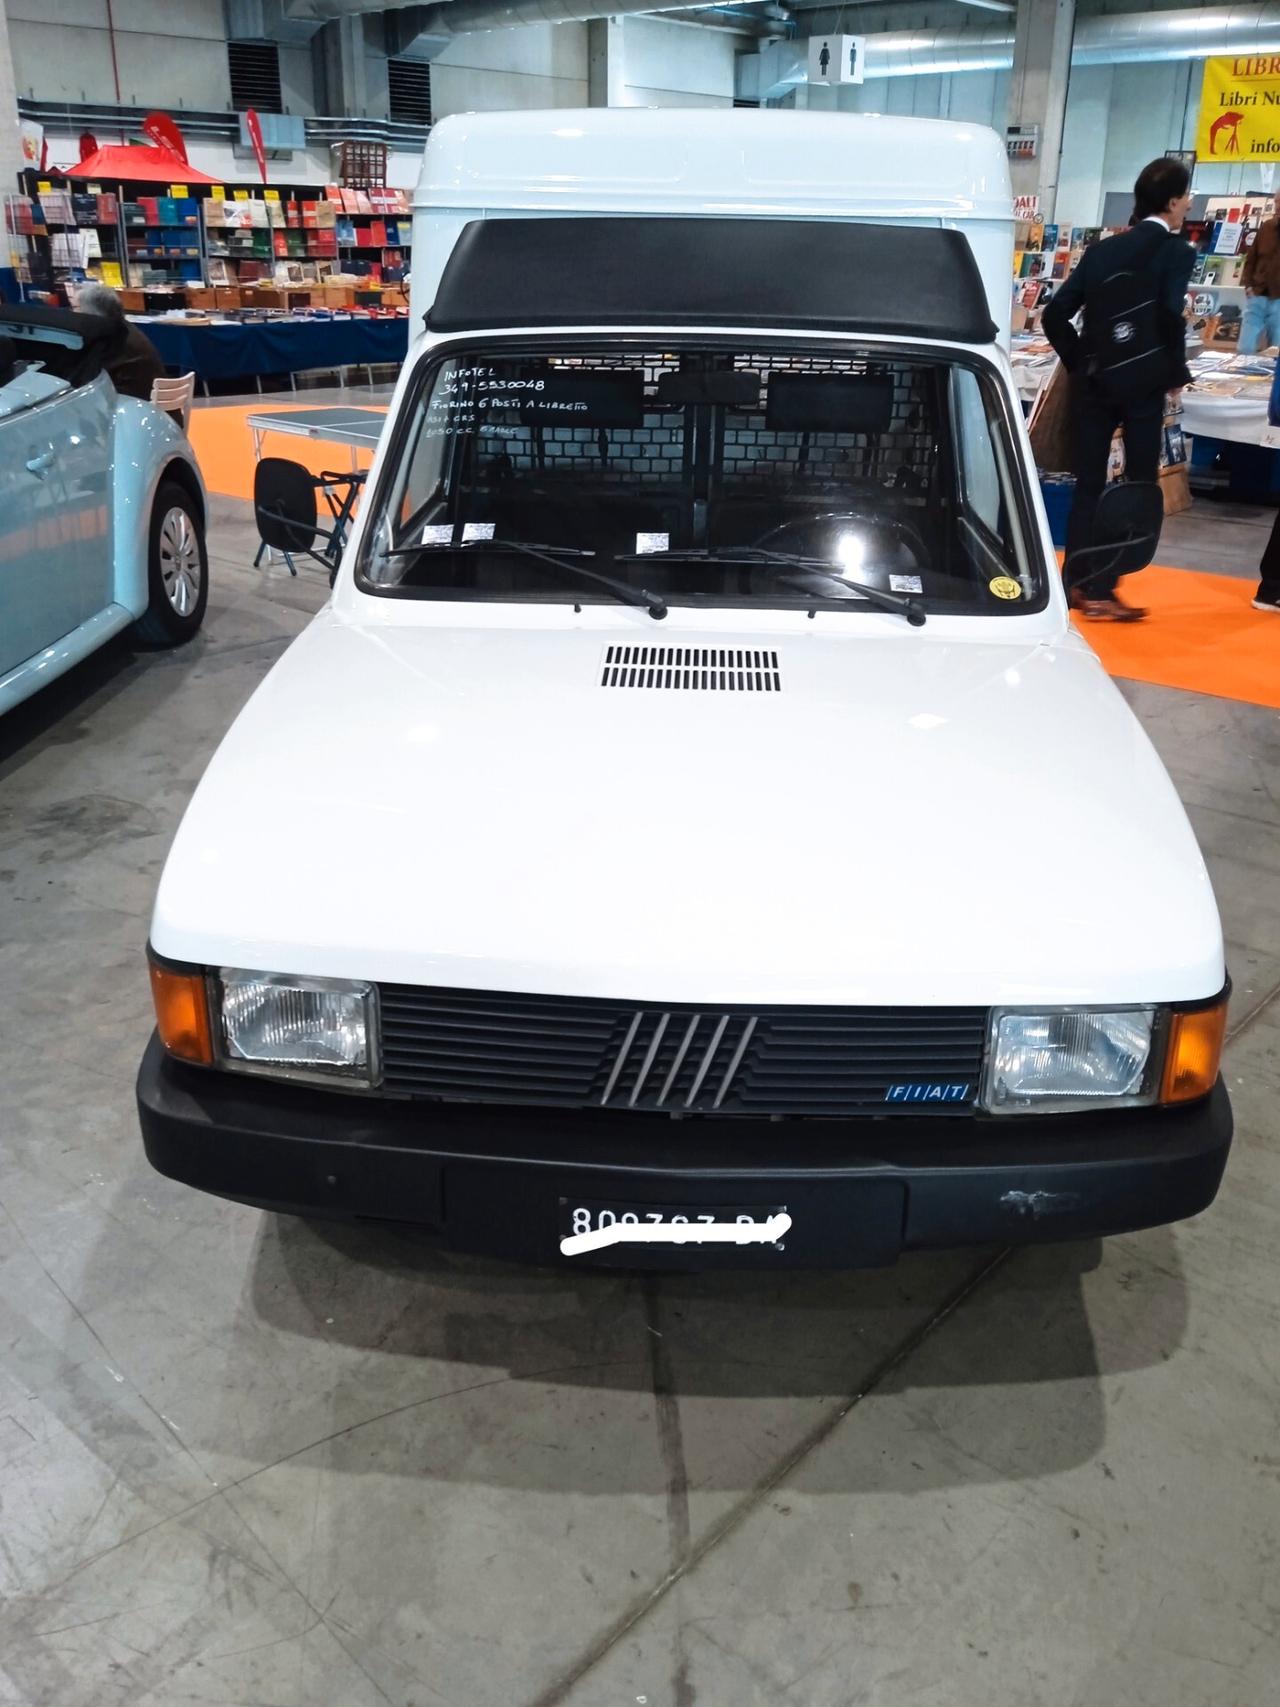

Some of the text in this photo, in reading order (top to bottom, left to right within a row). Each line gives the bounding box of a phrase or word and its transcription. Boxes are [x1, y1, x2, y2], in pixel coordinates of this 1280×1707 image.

[1219, 91, 1258, 107] Libri
[1250, 137, 1280, 154] info
[431, 399, 475, 410] FIORINO
[478, 397, 489, 408] 6
[491, 398, 521, 408] POSTI
[526, 400, 535, 408] A
[888, 1084, 967, 1100] FIAT
